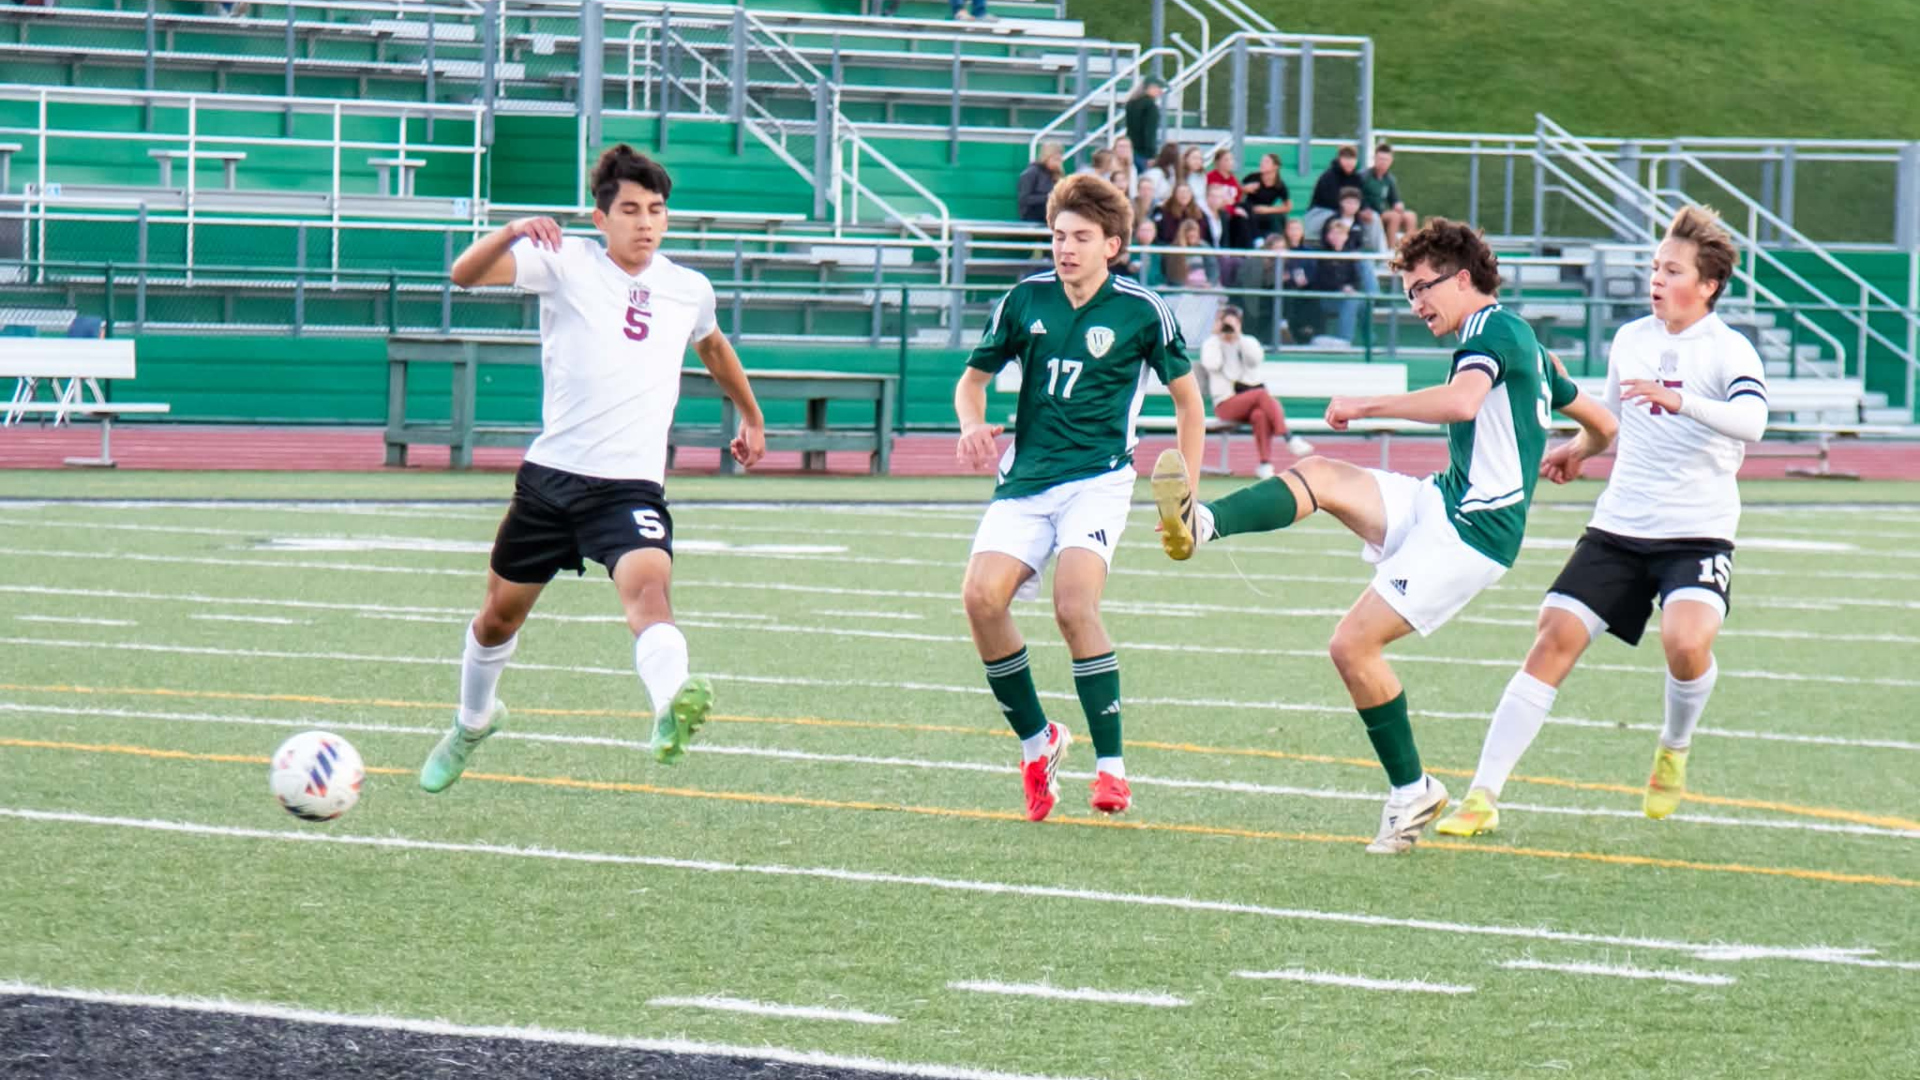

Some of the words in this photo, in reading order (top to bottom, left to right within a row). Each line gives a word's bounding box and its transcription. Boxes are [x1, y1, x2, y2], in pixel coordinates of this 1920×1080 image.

[623, 305, 652, 341] 5
[1047, 357, 1083, 399] 17
[632, 509, 666, 540] 5
[1698, 553, 1733, 593] 15
